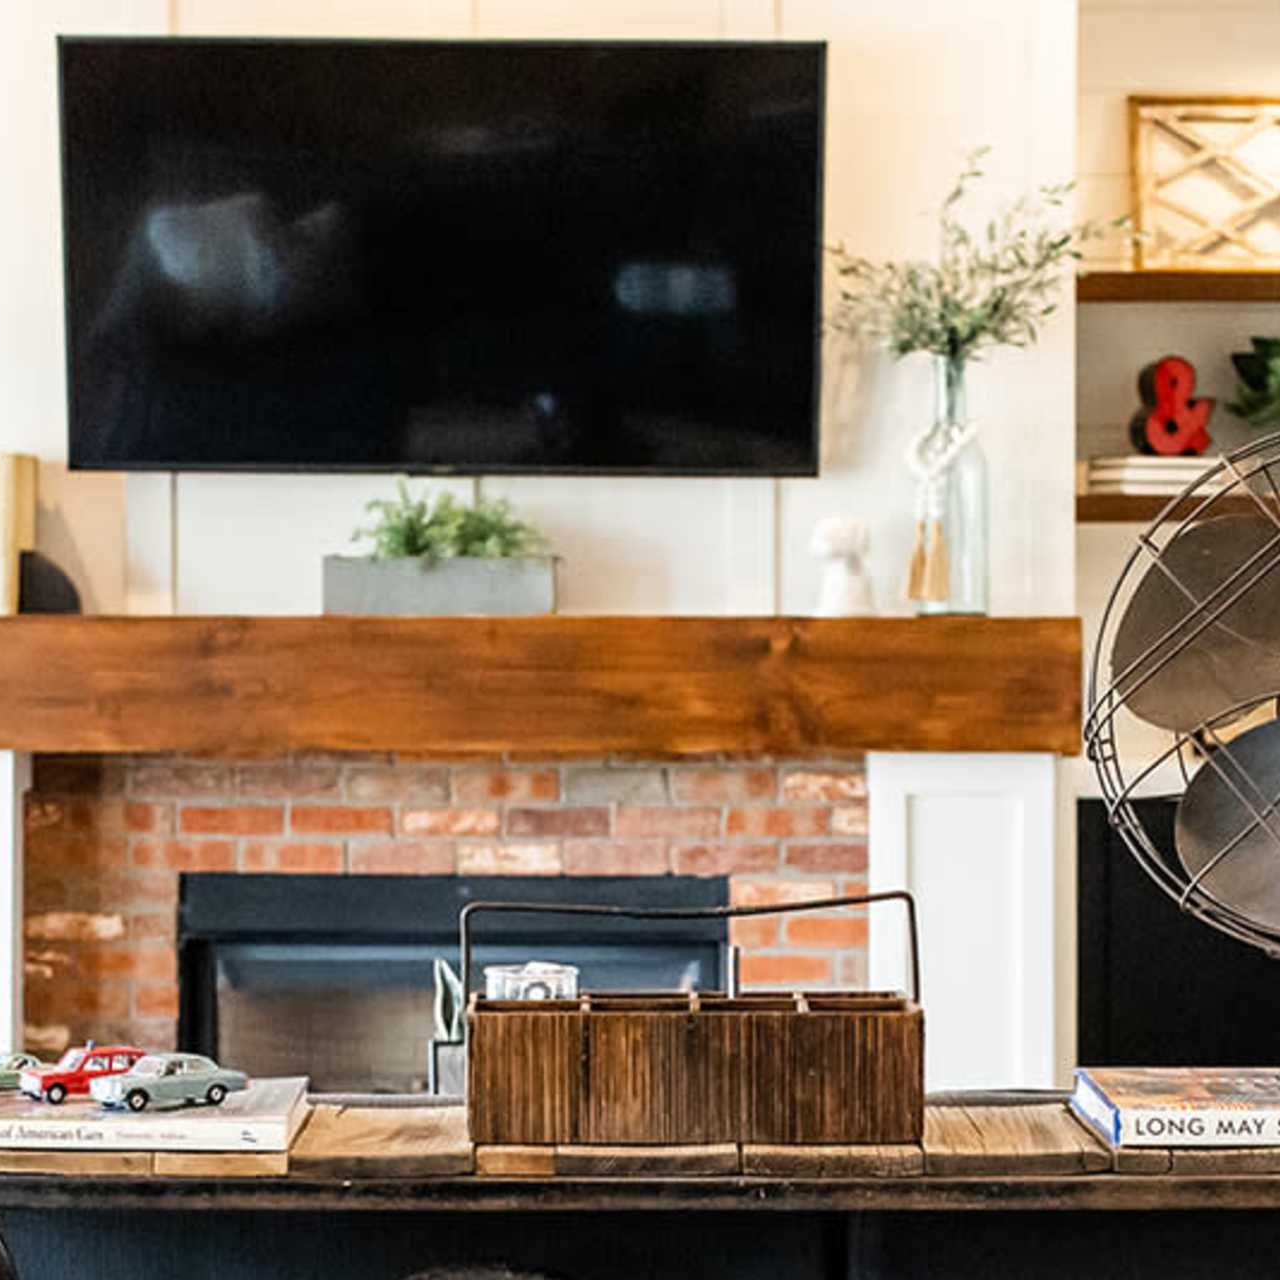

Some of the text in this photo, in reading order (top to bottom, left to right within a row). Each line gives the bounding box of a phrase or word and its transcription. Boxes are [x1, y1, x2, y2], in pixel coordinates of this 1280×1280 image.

[0, 1123, 14, 1139] of
[17, 1124, 74, 1140] American
[75, 1125, 104, 1141] Cars
[1135, 1118, 1205, 1136] LONG
[1216, 1119, 1265, 1135] MAY
